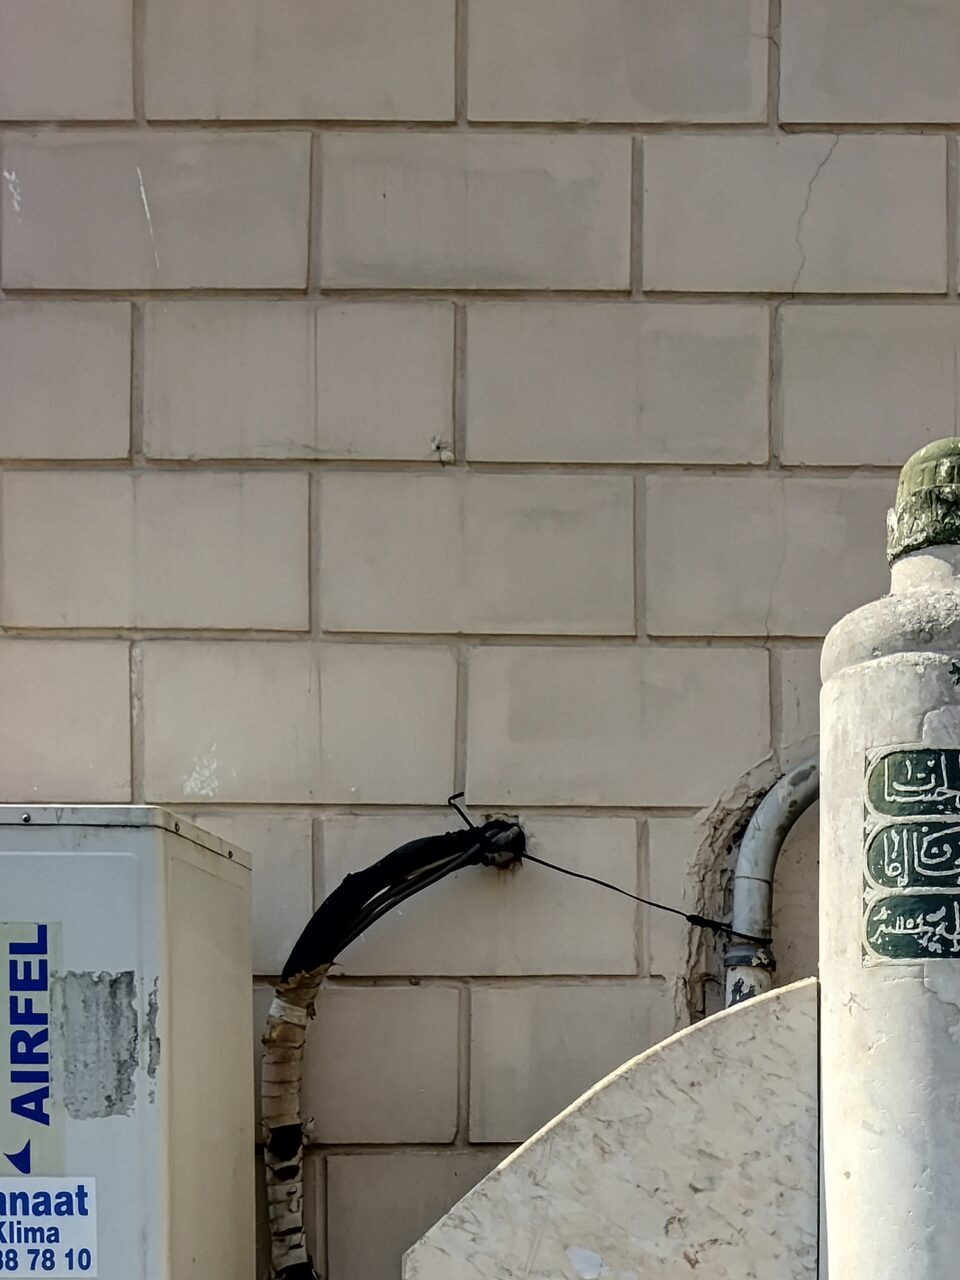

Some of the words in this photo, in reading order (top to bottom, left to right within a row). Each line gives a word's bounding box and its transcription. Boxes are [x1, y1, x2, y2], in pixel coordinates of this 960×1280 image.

[9, 924, 50, 1126] AIRFEL
[27, 1249, 55, 1271] 78
[65, 1248, 91, 1271] 10
